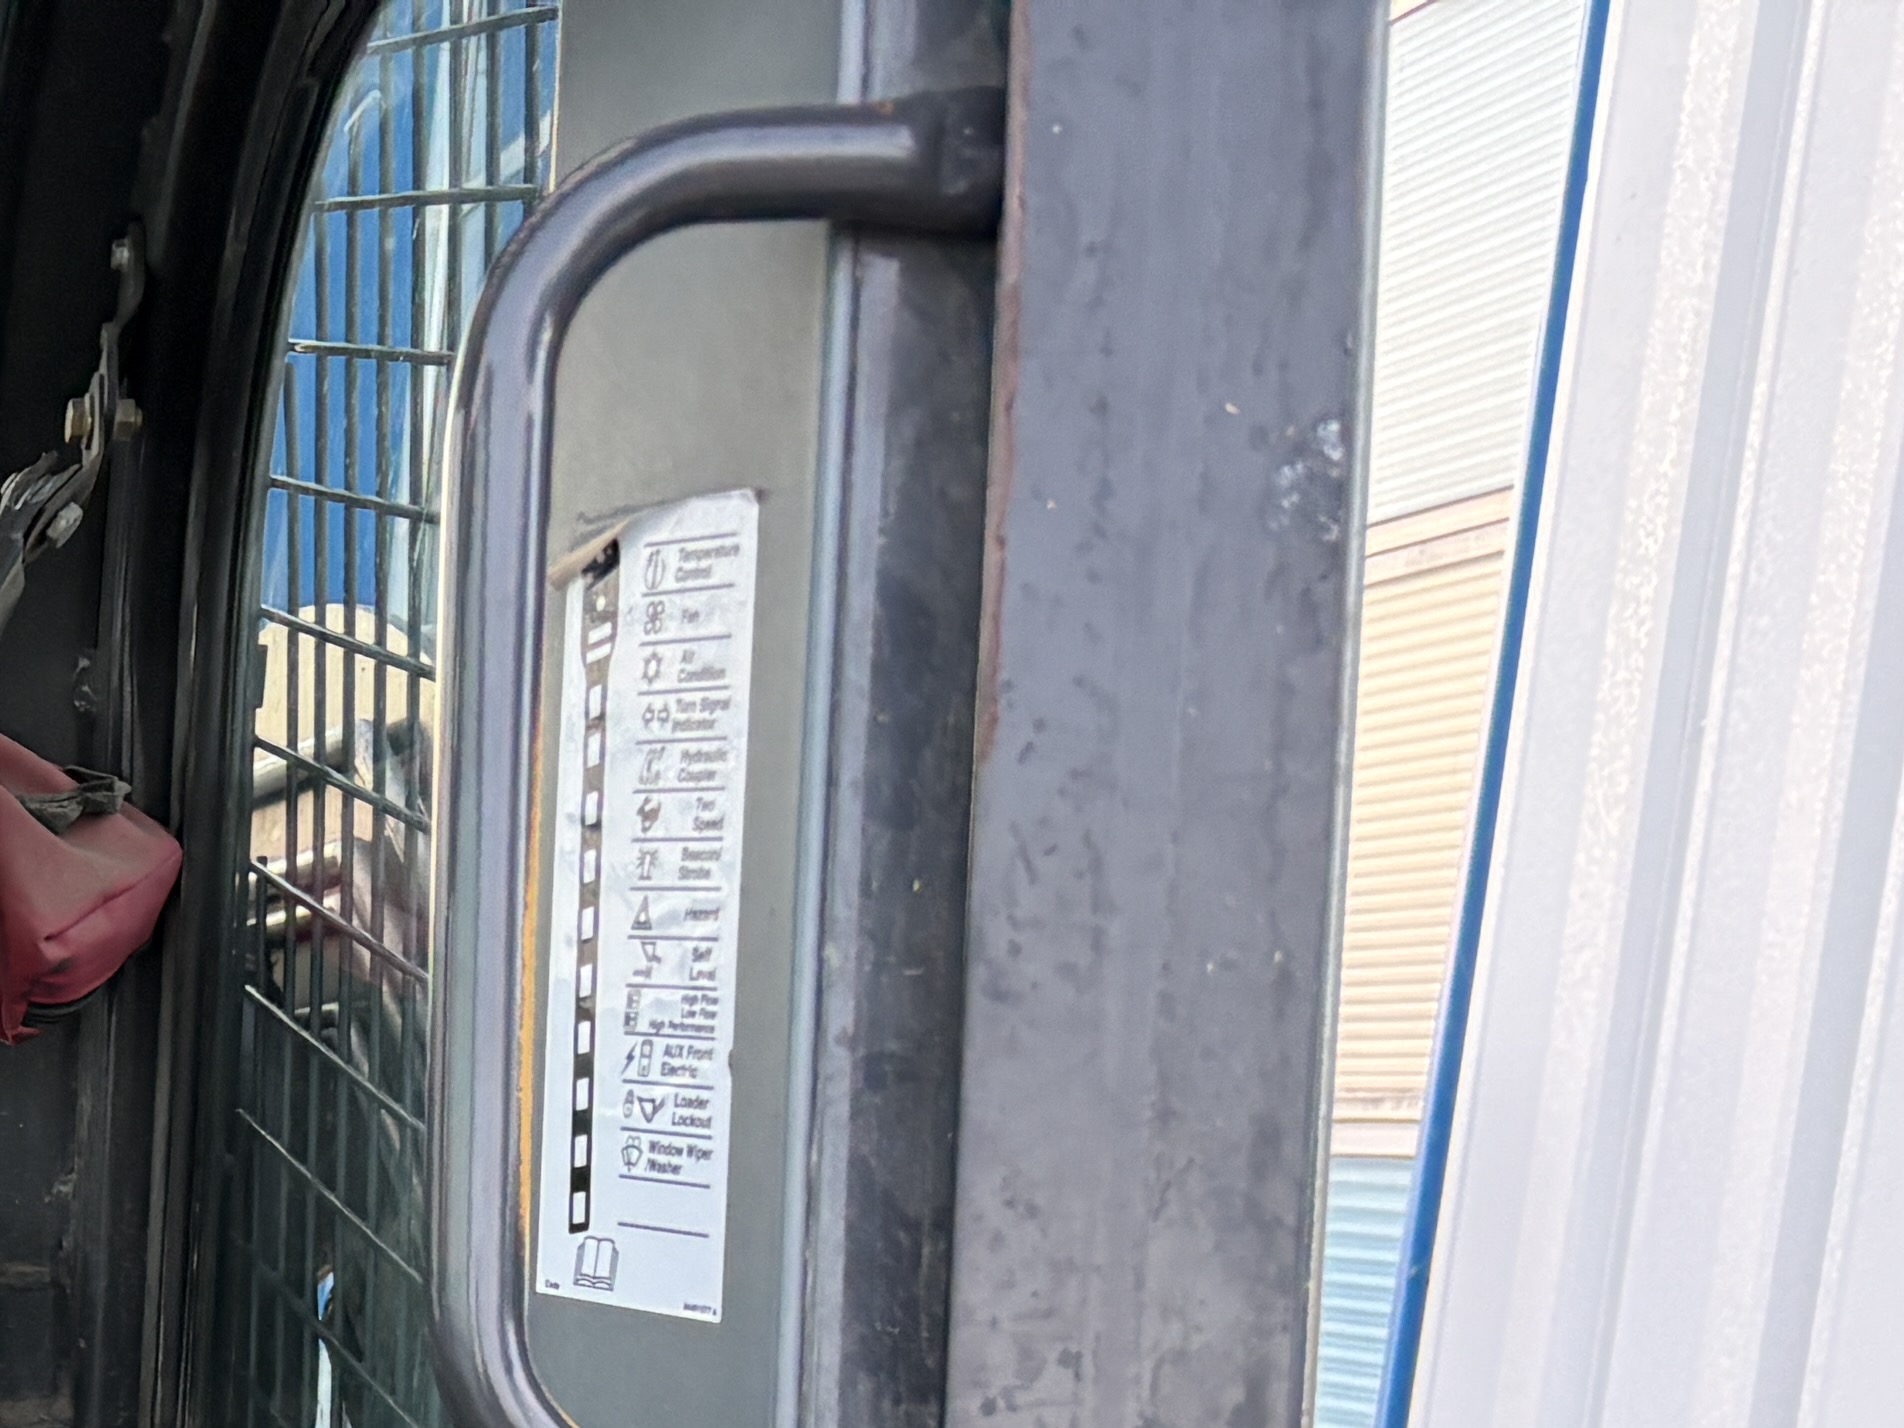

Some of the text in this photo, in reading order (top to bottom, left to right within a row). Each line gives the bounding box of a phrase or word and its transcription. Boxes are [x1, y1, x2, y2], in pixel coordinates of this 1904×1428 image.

[678, 544, 740, 563] Temperature
[674, 565, 713, 584] Control
[678, 667, 726, 684] Condition
[662, 1044, 714, 1062] AUX Front
[660, 1061, 699, 1079] Electric
[673, 1093, 710, 1110] Loader
[671, 1111, 713, 1130] Lockout
[648, 1139, 714, 1162] Window Wiper
